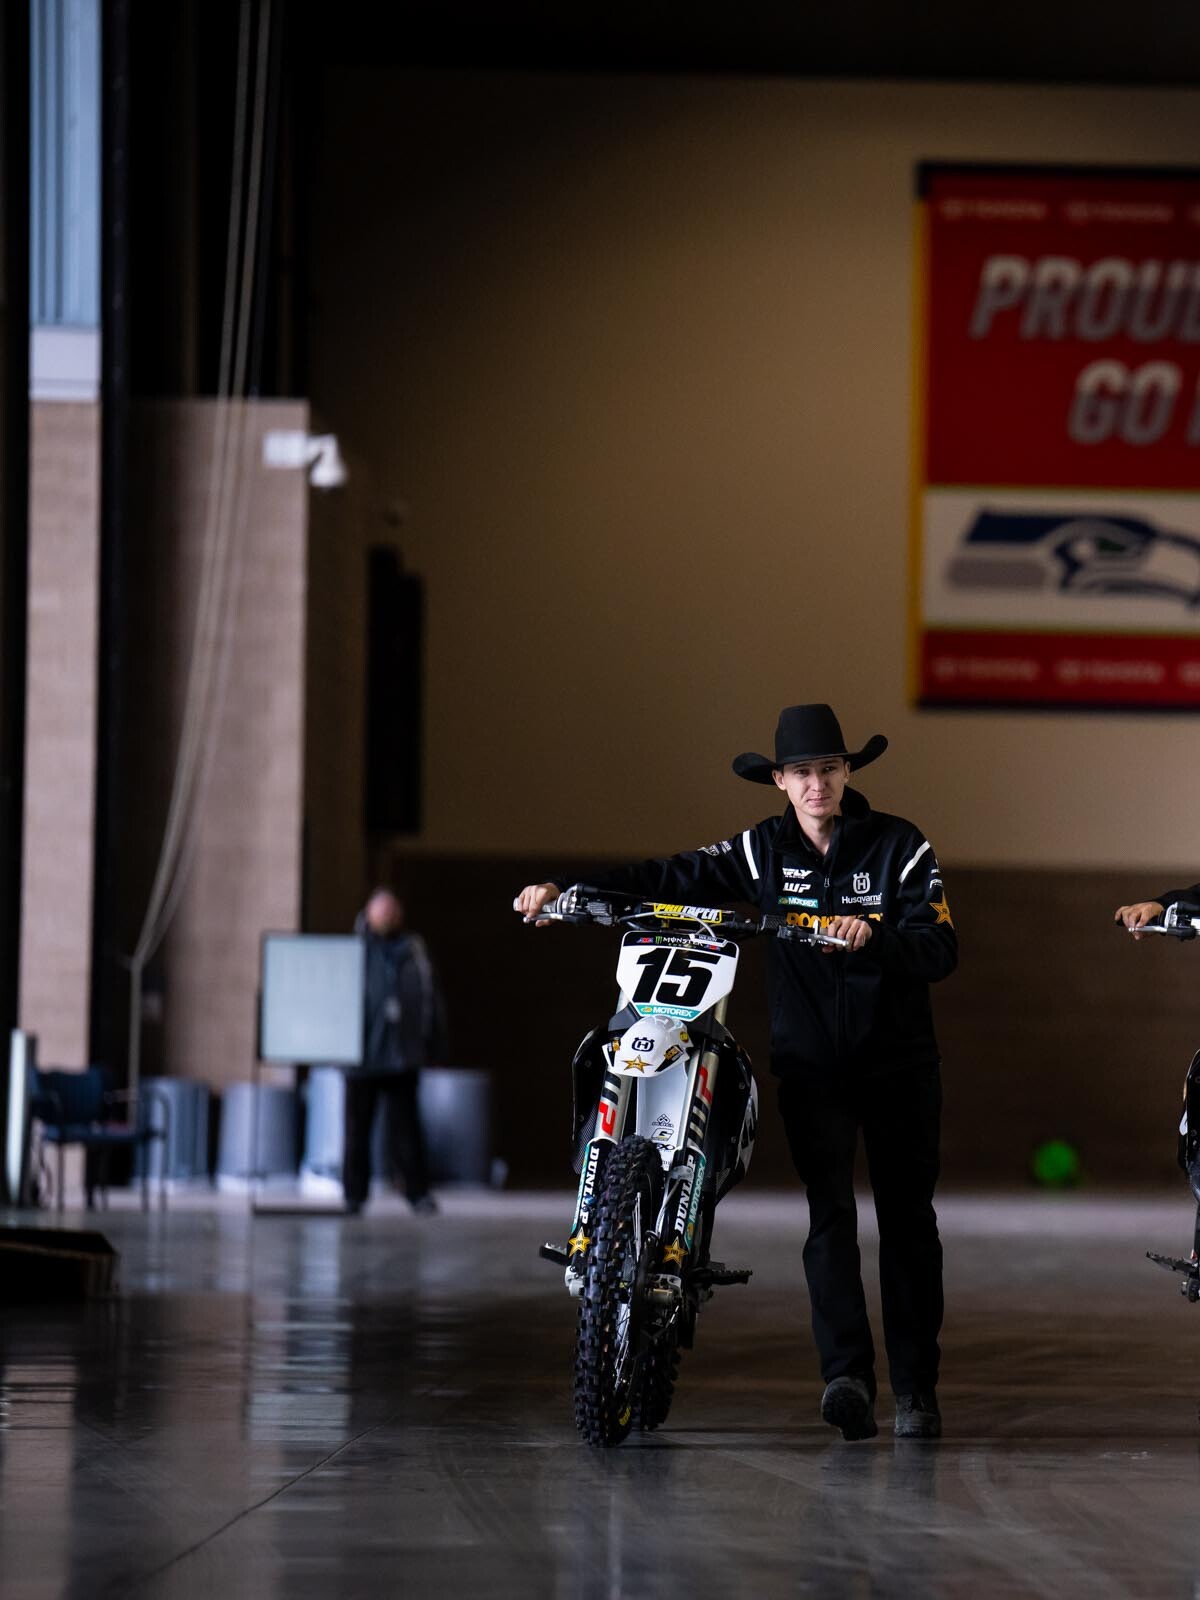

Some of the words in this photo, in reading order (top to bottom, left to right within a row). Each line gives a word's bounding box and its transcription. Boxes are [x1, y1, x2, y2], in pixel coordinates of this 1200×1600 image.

[1068, 361, 1182, 444] GO
[783, 882, 811, 893] WP
[788, 897, 817, 908] MOTOREX
[841, 894, 882, 905] Husqvarna
[626, 947, 722, 1007] 15
[653, 1006, 694, 1017] MOTOREX
[675, 1154, 697, 1235] DUNLP
